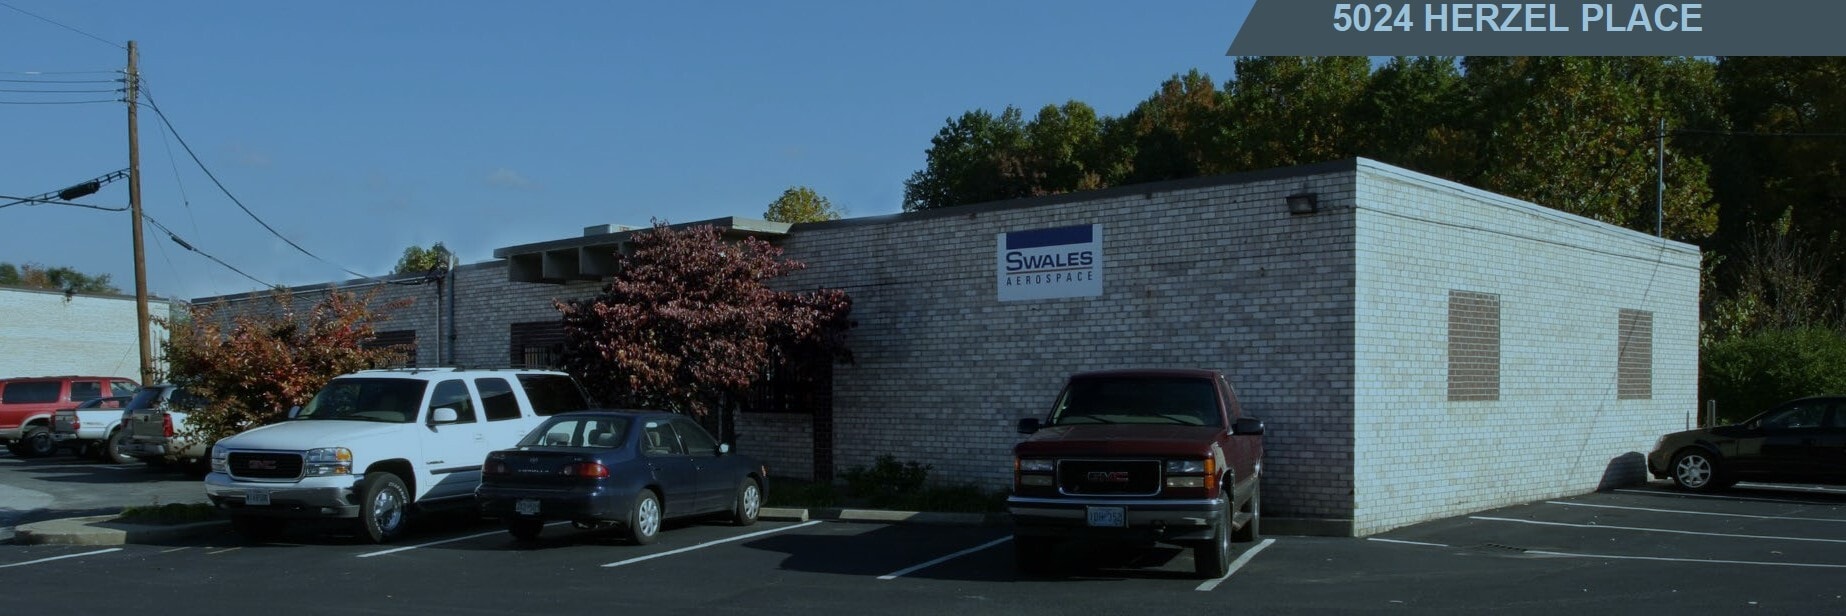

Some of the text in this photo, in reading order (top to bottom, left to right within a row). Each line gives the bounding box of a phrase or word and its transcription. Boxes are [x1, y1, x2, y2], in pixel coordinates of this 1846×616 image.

[1006, 251, 1093, 271] SWALES
[1006, 271, 1093, 286] AEROSPACE
[1088, 472, 1128, 481] GMC
